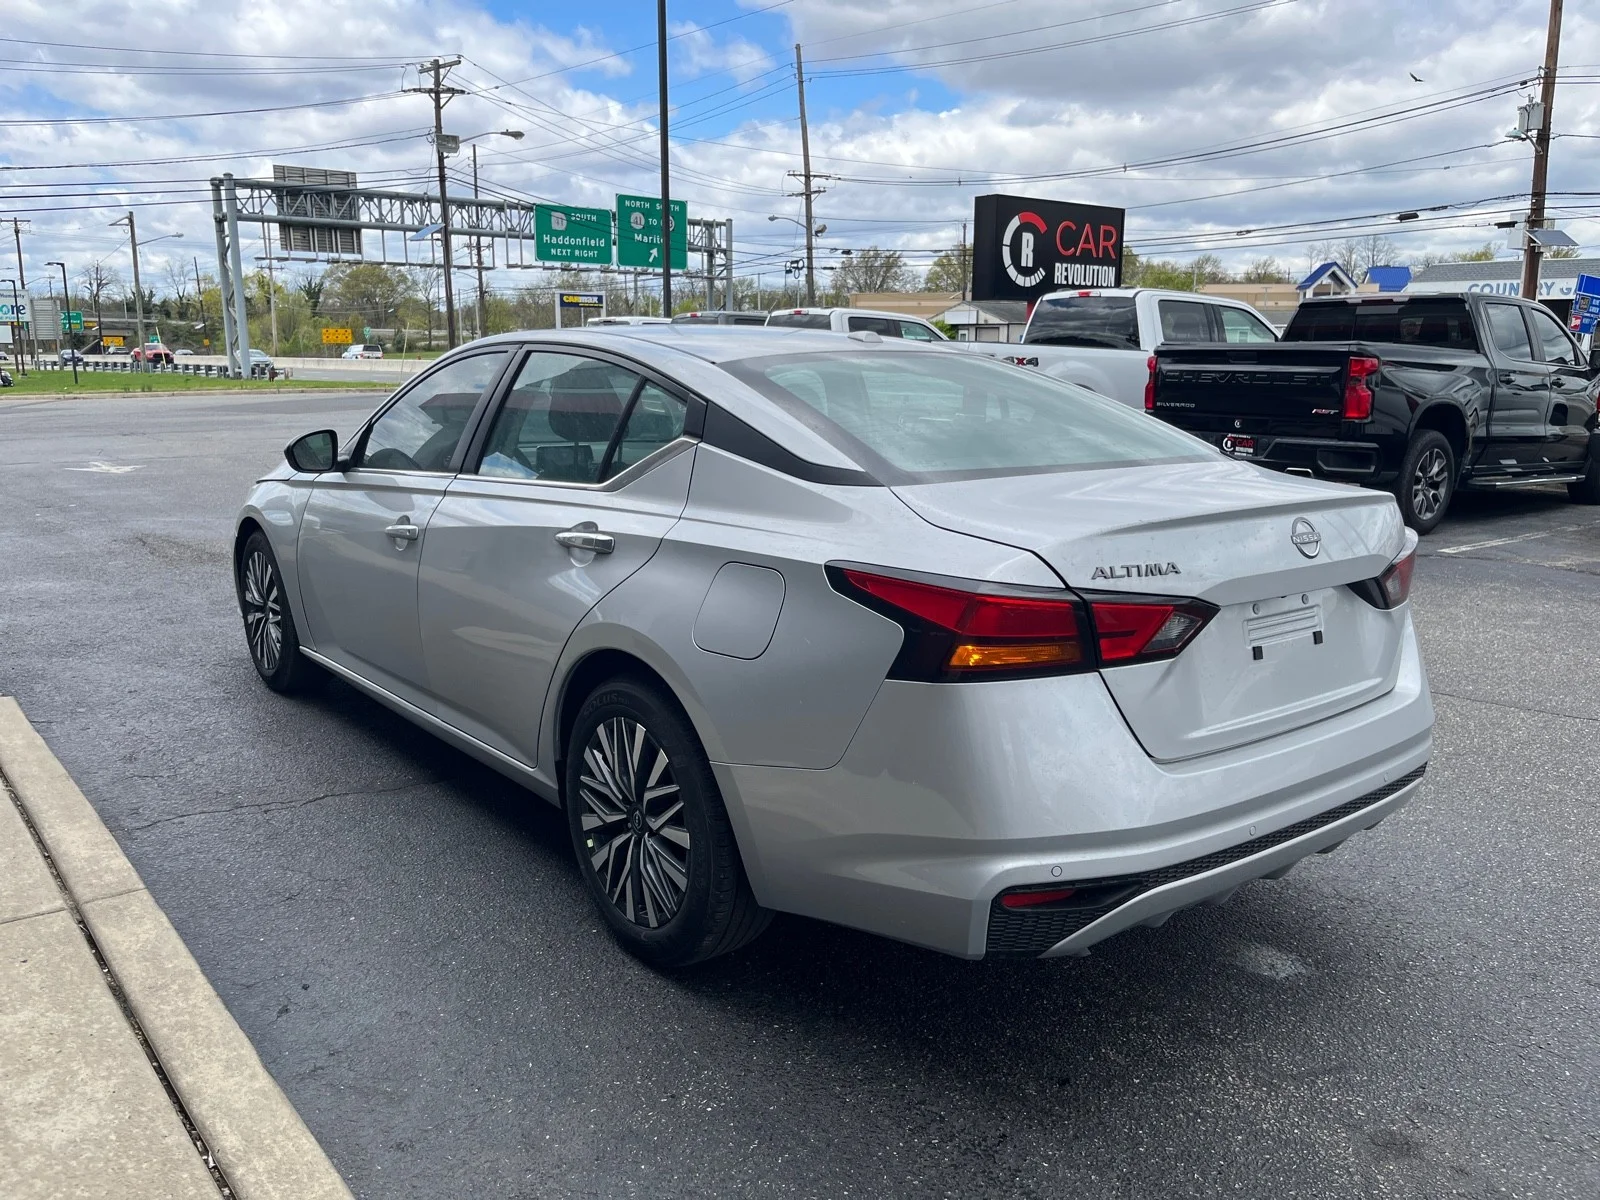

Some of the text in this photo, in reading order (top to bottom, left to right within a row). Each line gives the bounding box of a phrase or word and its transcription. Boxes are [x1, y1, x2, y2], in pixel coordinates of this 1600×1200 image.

[625, 199, 680, 212] NORTH STH
[570, 212, 597, 222] SOUTH
[648, 218, 658, 226] TO
[543, 234, 605, 247] Haddonfield
[1056, 220, 1117, 259] CAR
[551, 248, 598, 258] NEXT RIGHT
[1053, 262, 1116, 287] REVOLUTION
[1468, 281, 1555, 296] COUNRY
[1165, 372, 1332, 386] CHEVROLET
[1292, 532, 1321, 543] NISSA
[1091, 562, 1182, 580] ALTIMA
